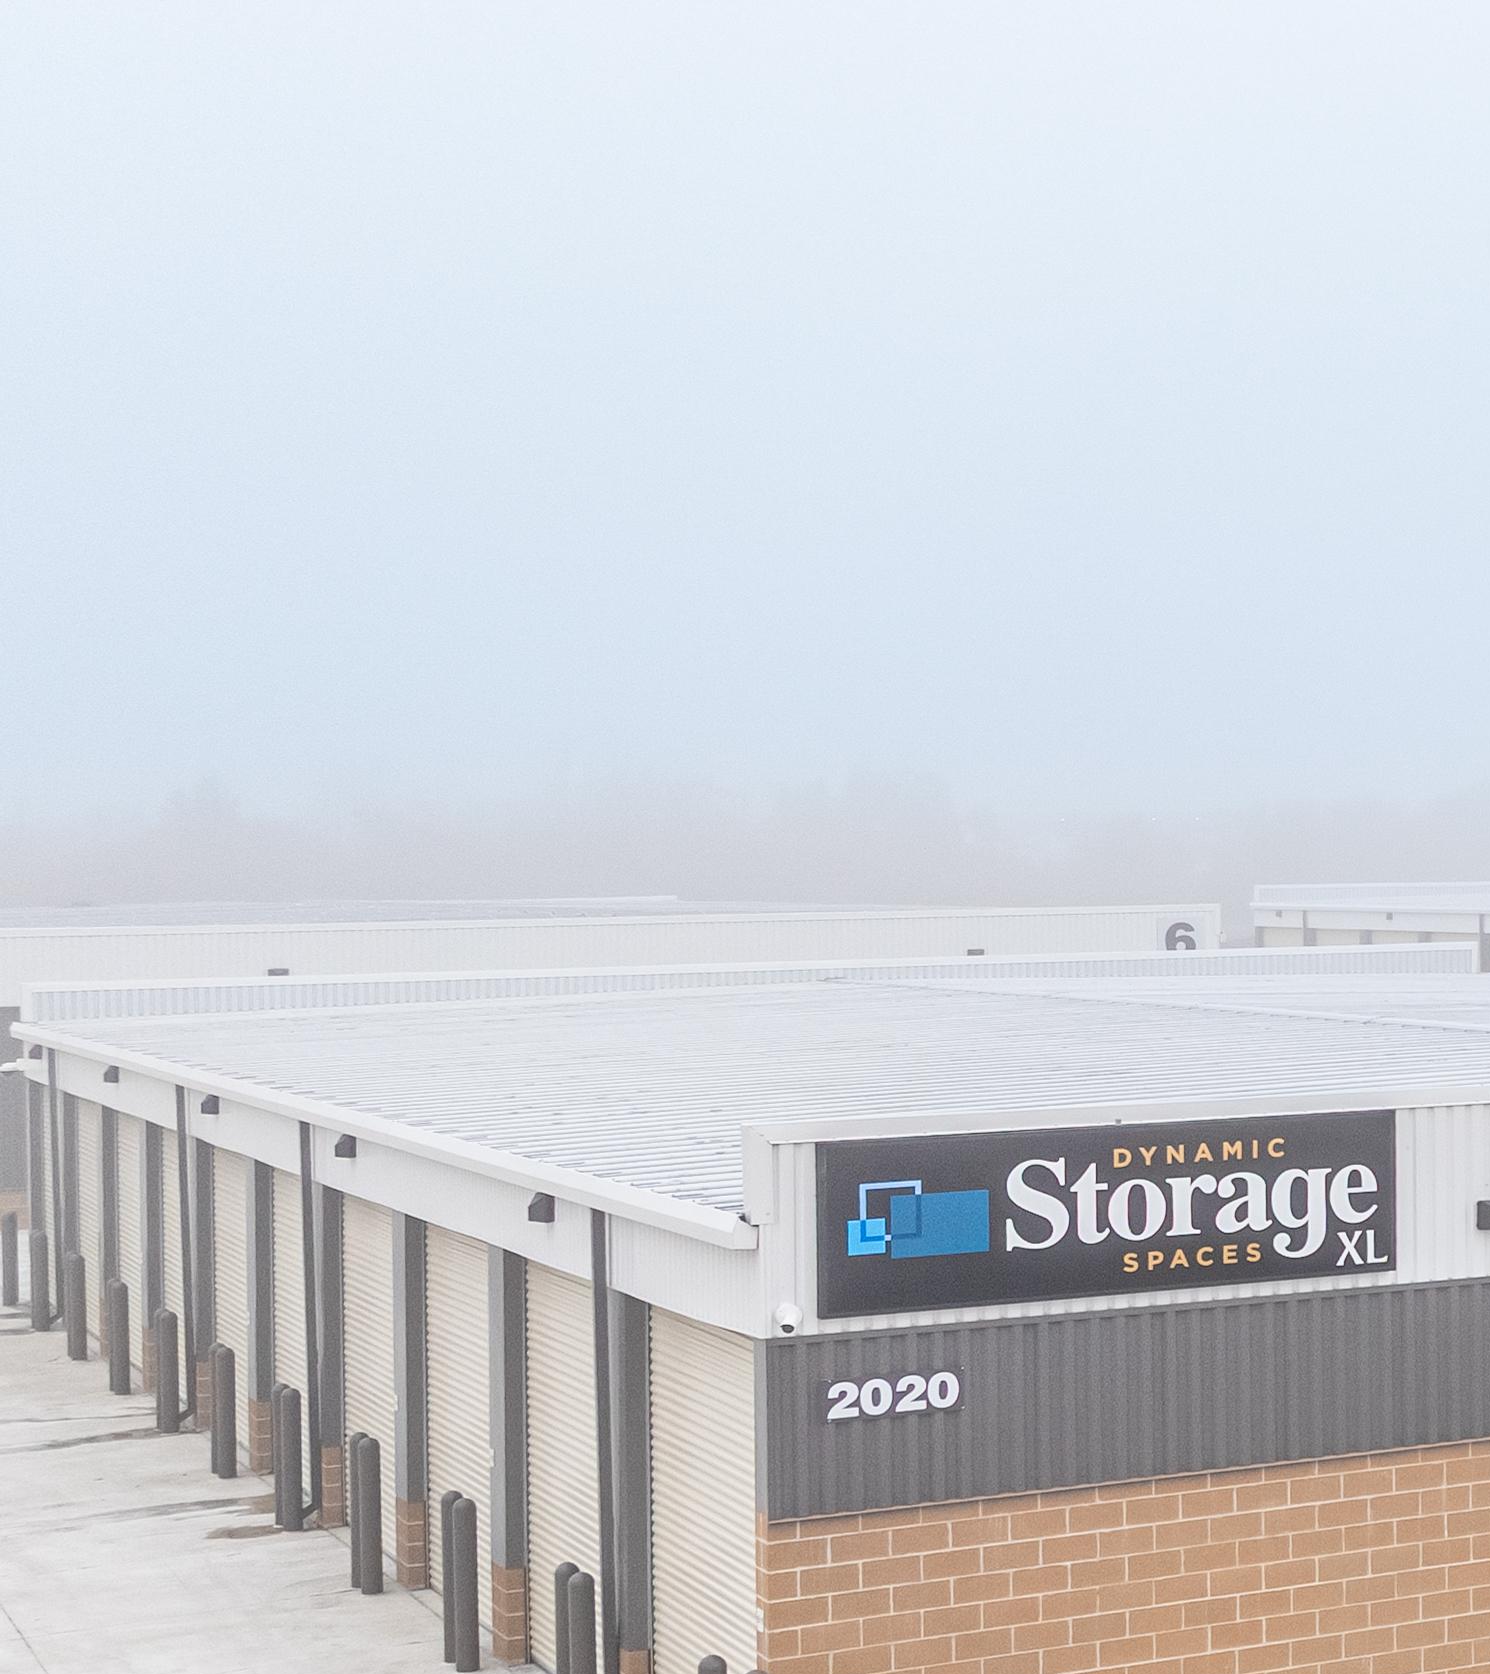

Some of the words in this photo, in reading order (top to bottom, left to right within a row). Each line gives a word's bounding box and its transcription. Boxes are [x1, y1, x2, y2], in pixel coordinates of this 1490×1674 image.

[1165, 922, 1197, 950] 6
[1113, 1138, 1286, 1168] DYNAMIC
[1005, 1156, 1379, 1259] Storage
[1123, 1242, 1262, 1273] SPACES
[1335, 1230, 1389, 1267] XL
[827, 1371, 960, 1420] 2020
